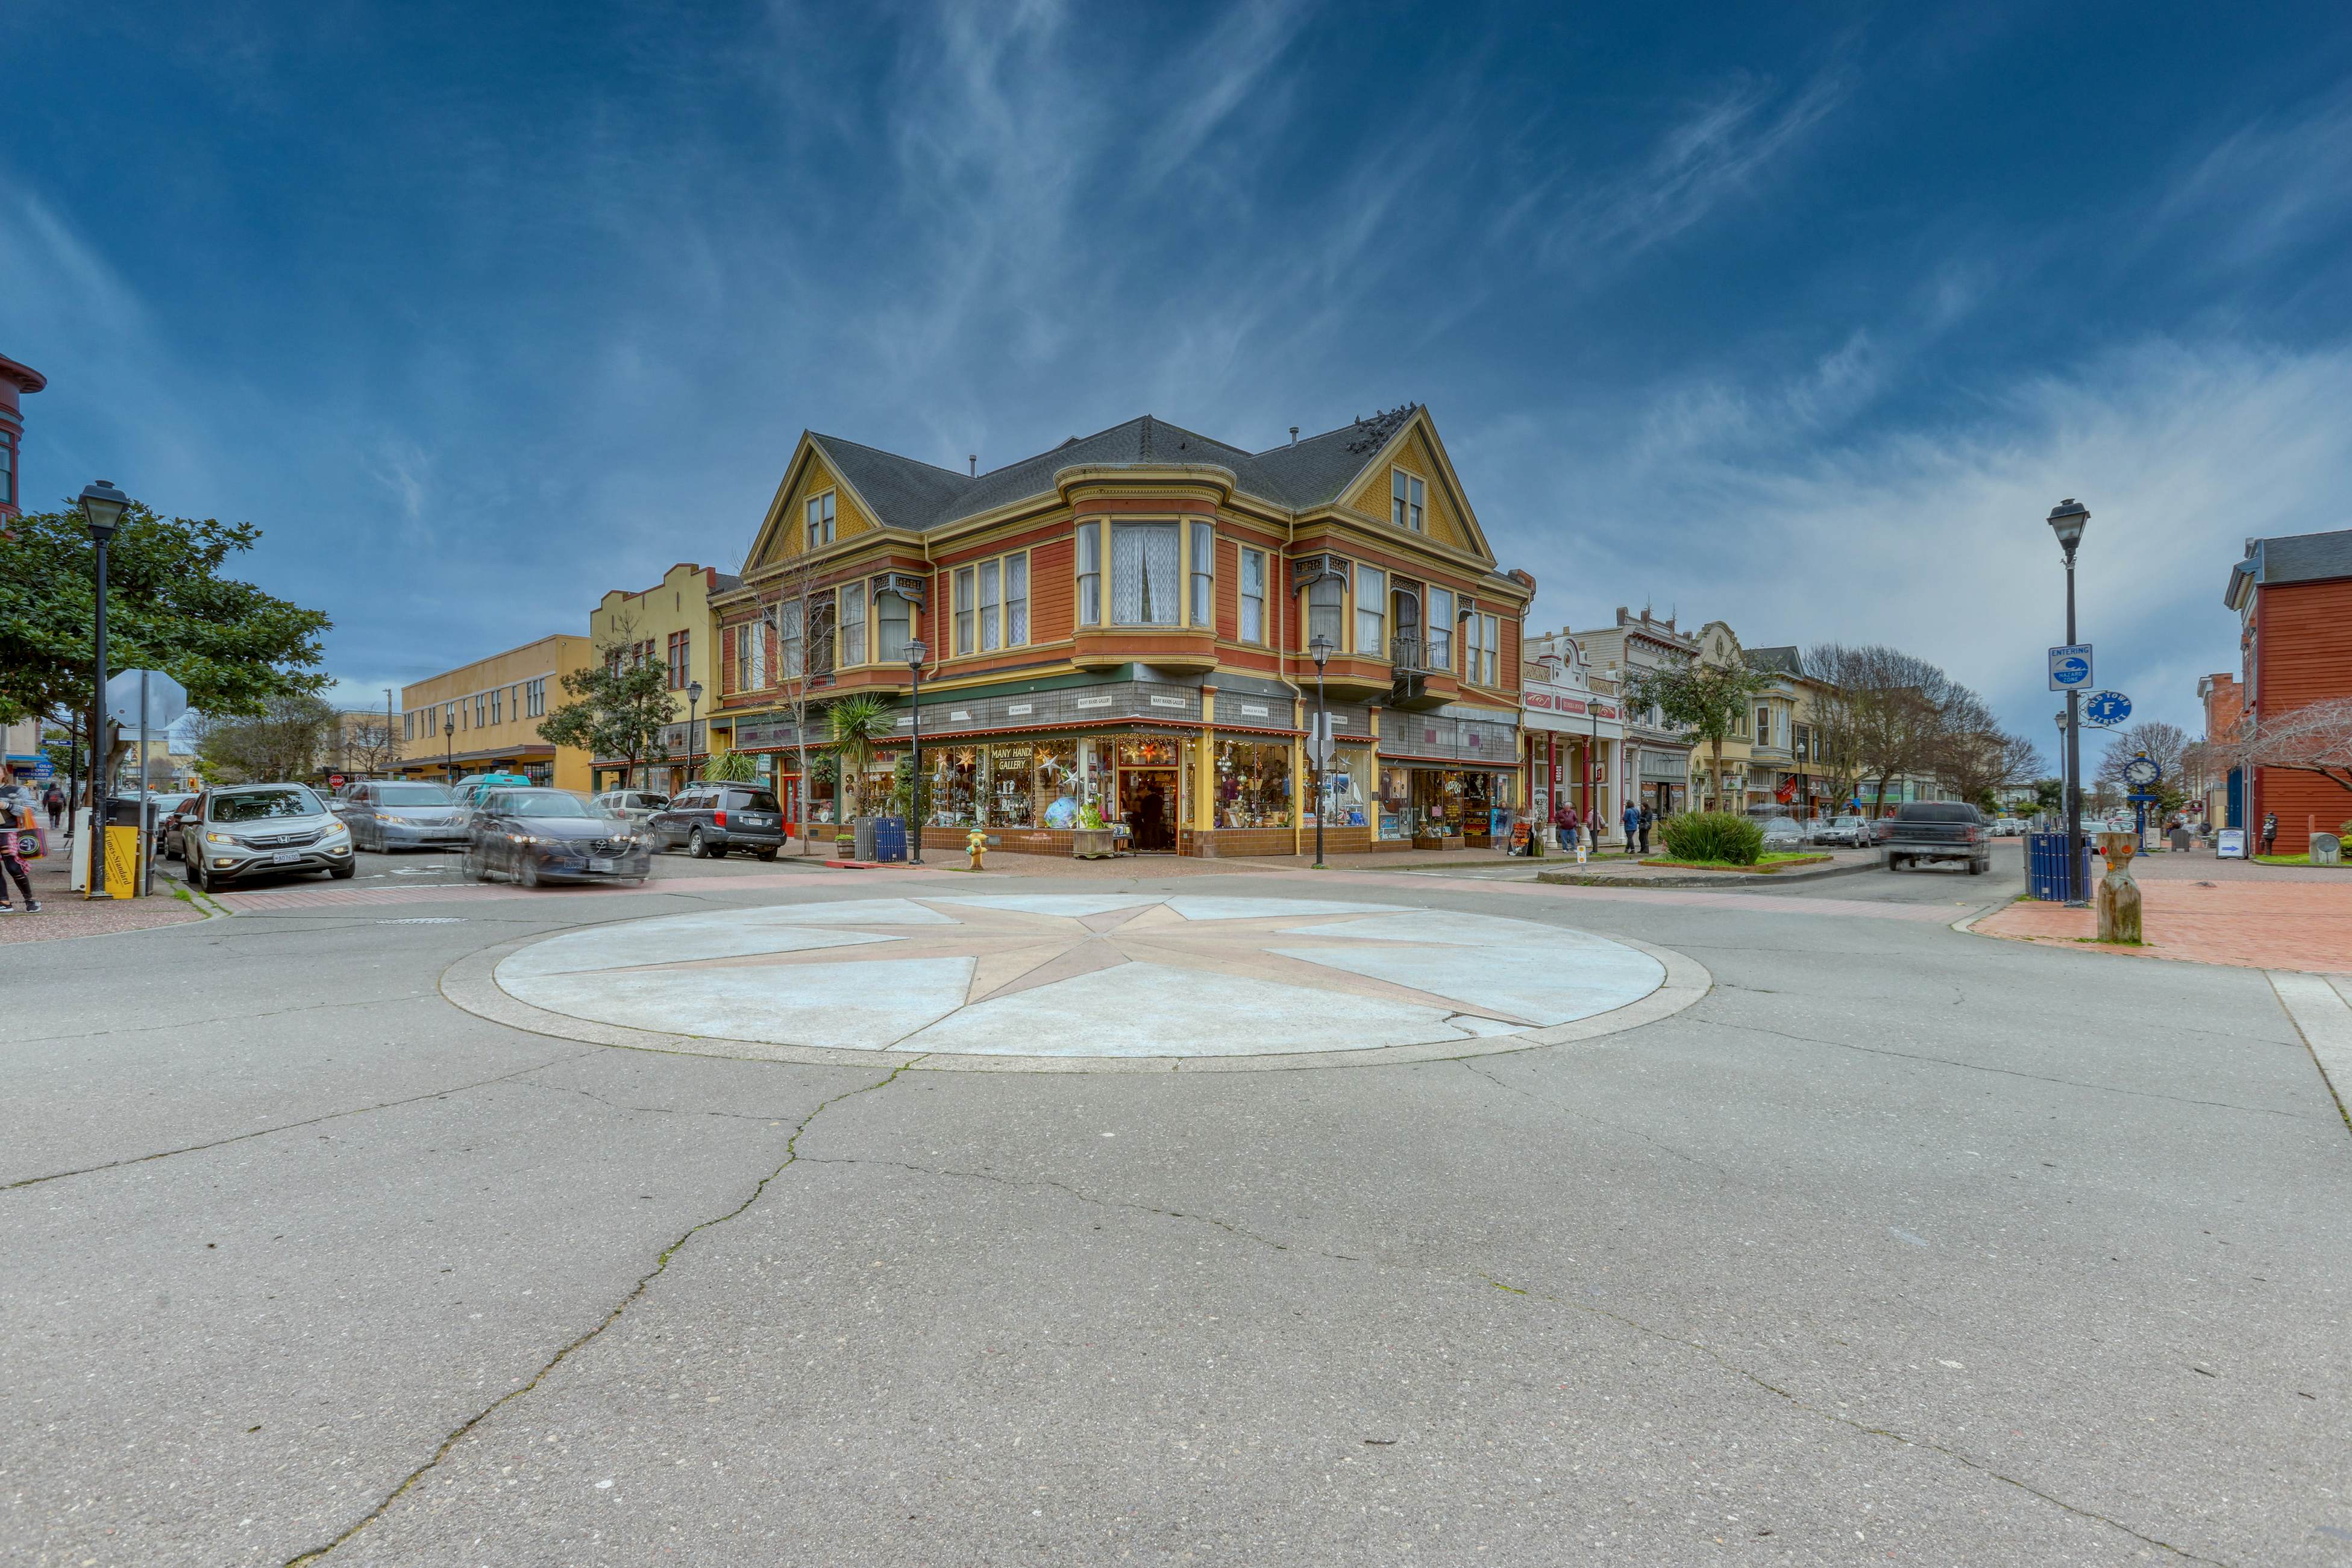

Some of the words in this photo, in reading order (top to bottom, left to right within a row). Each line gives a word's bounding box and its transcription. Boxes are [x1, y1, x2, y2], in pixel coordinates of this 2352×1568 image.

[2051, 647, 2089, 656] ENTERING
[2089, 695, 2103, 708] OLD
[2106, 692, 2131, 706] TOWN
[2103, 702, 2116, 715] F
[2092, 713, 2127, 724] STREET
[992, 748, 1012, 759] MANY
[999, 759, 1026, 770] GALLERY
[1445, 780, 1462, 794] WORKS
